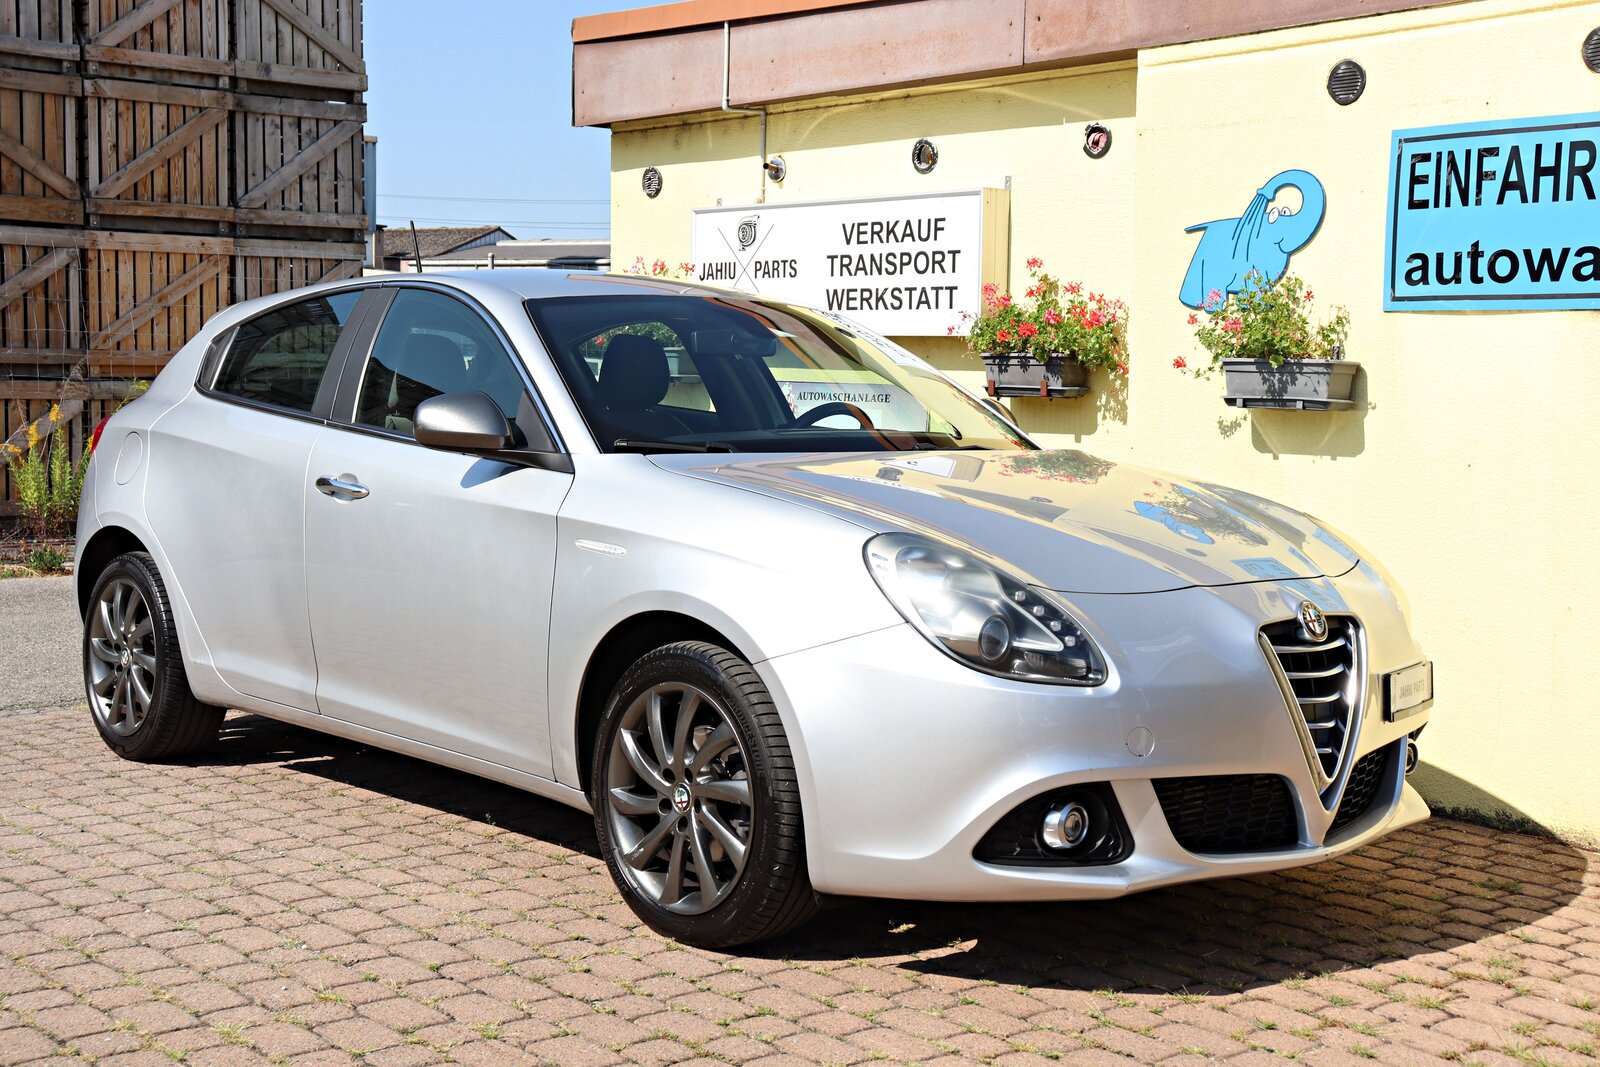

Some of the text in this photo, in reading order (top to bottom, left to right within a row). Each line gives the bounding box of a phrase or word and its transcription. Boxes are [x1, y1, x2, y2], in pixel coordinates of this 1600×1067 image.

[1407, 140, 1597, 210] EINFAHR
[842, 217, 946, 245] VERKAUF
[699, 259, 798, 281] JAHIU PARTS
[827, 250, 961, 277] TRANSPORT
[1404, 239, 1600, 286] autowa
[826, 286, 959, 311] WERKSTATT
[797, 391, 891, 404] AUTOWASCHANLAGE
